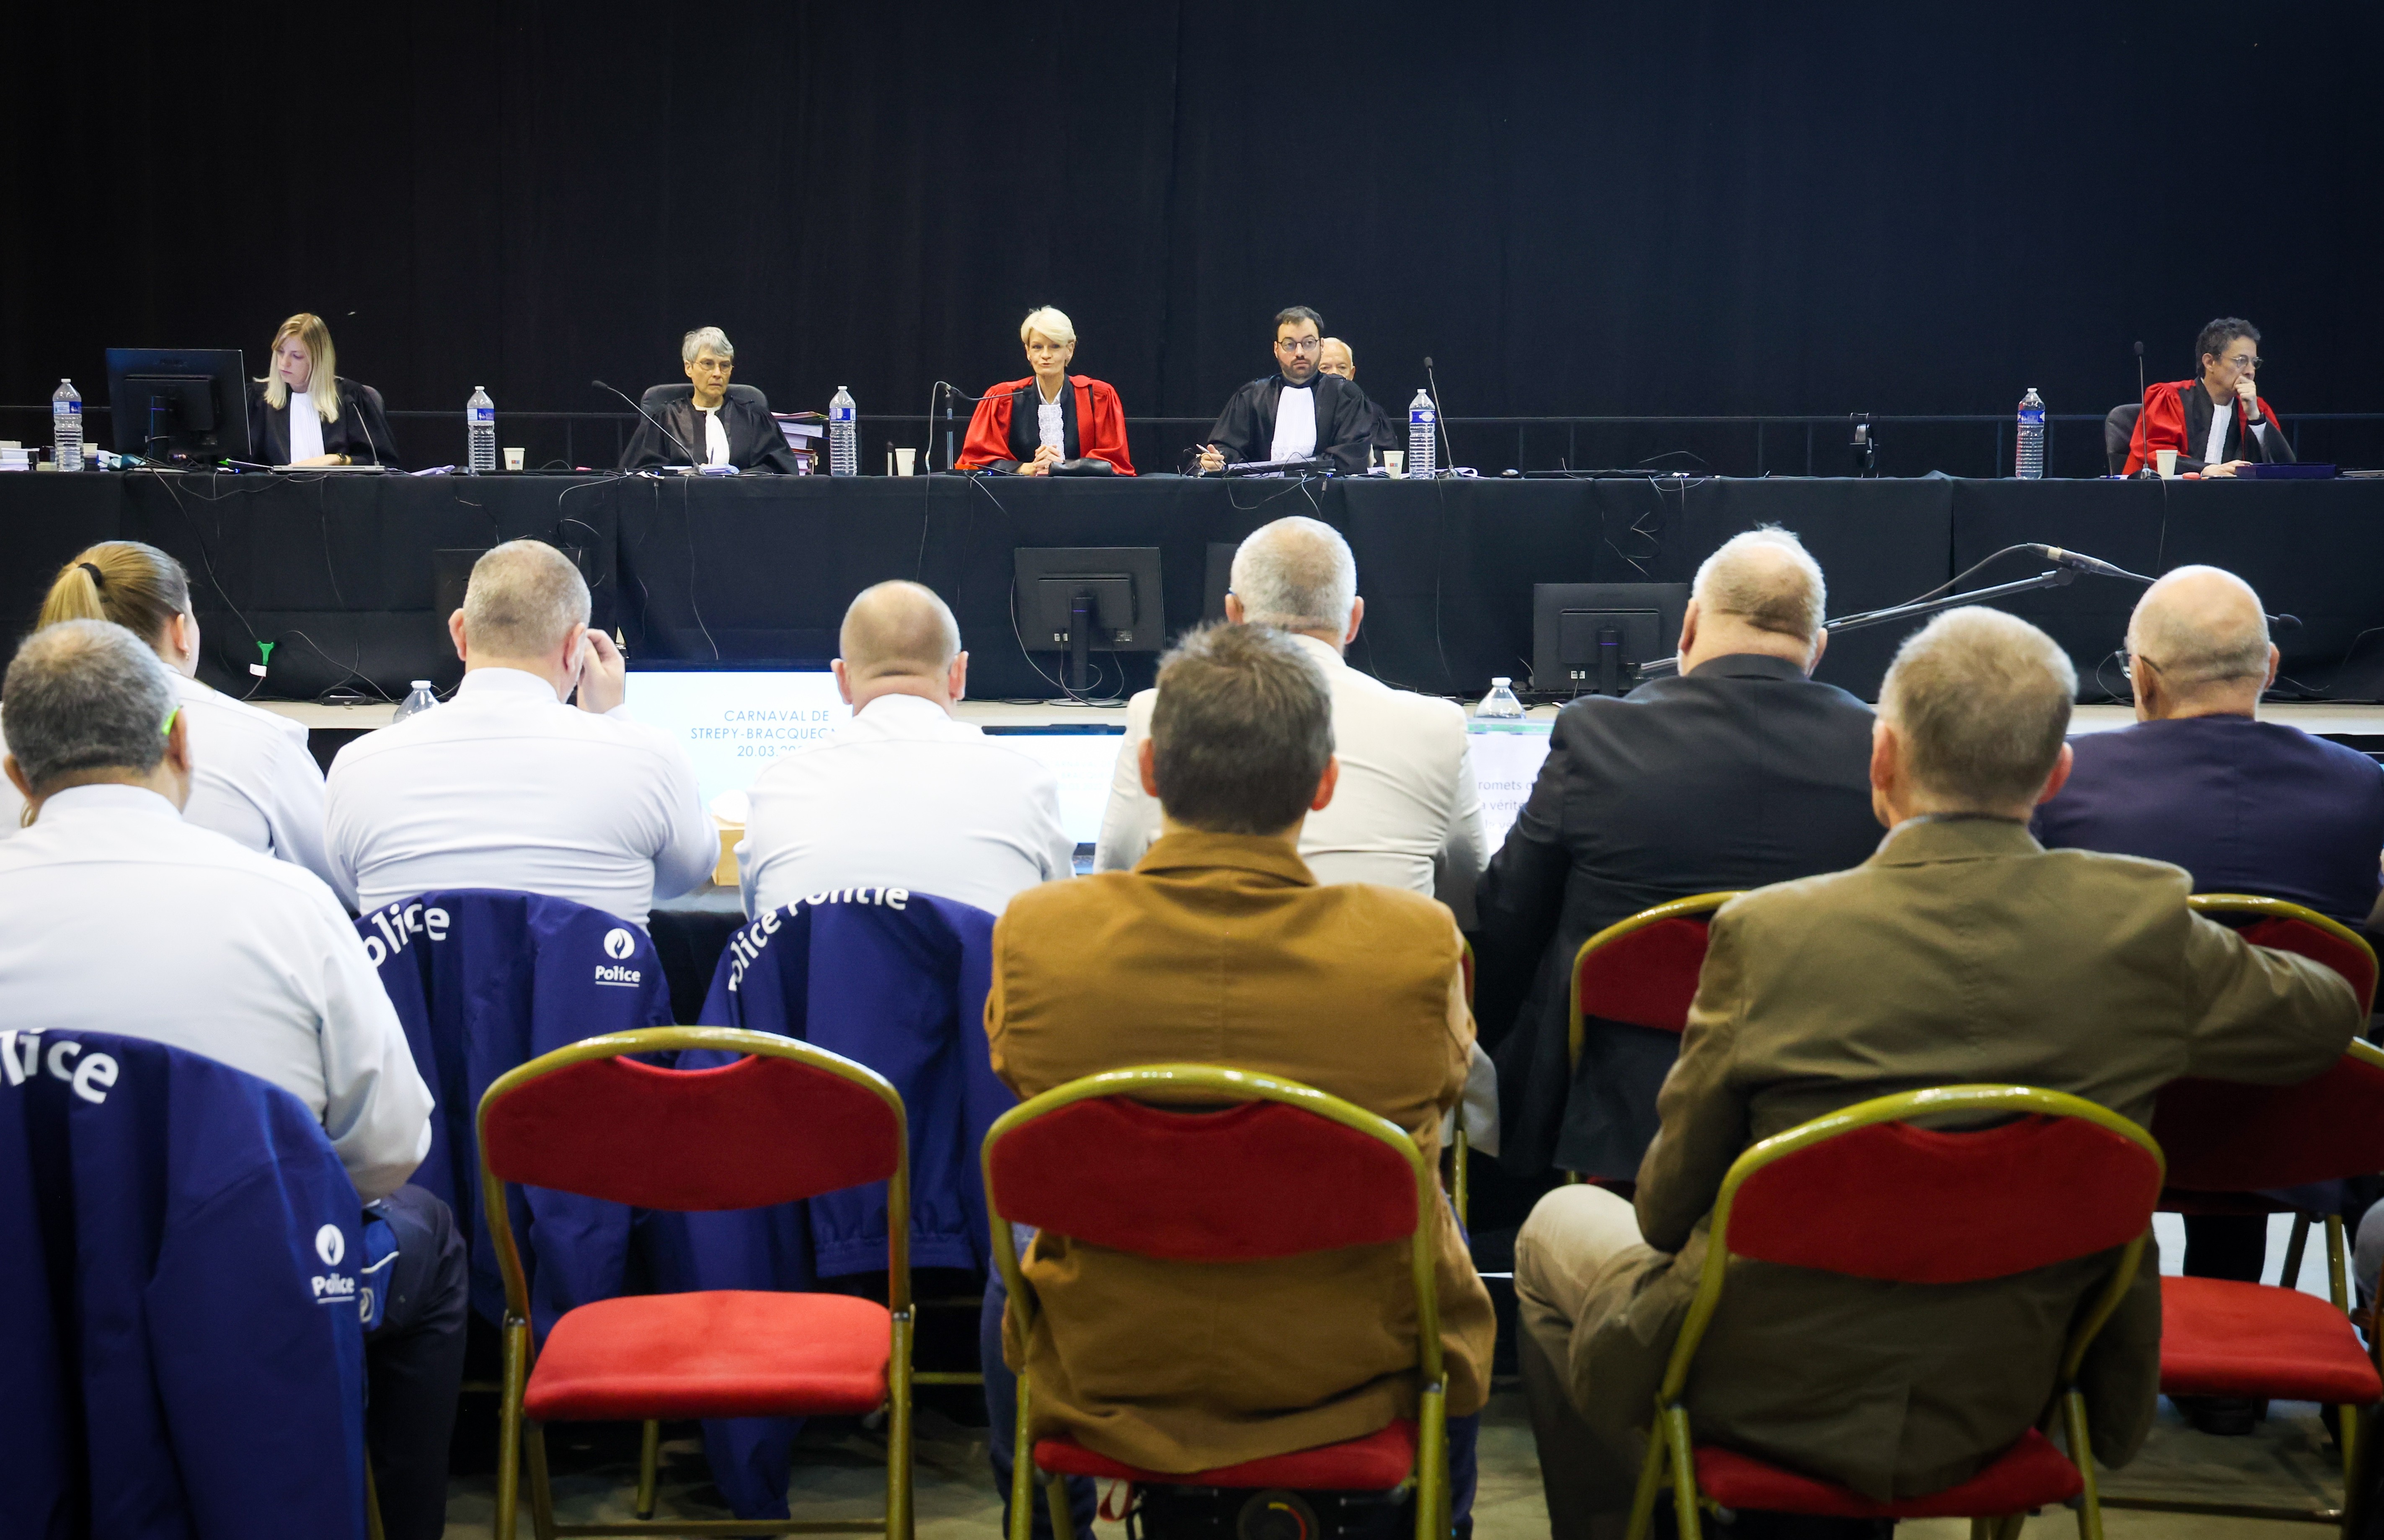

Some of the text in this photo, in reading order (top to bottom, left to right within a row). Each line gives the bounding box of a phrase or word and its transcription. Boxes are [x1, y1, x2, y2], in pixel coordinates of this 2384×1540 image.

[725, 710, 829, 721] CARNAVAL DE
[737, 745, 802, 757] 20.03.
[1478, 780, 1522, 790] romets
[364, 903, 450, 967] olice
[728, 910, 782, 992] olice
[595, 965, 641, 983] Police
[0, 1027, 119, 1104] lice
[311, 1272, 355, 1297] Police
